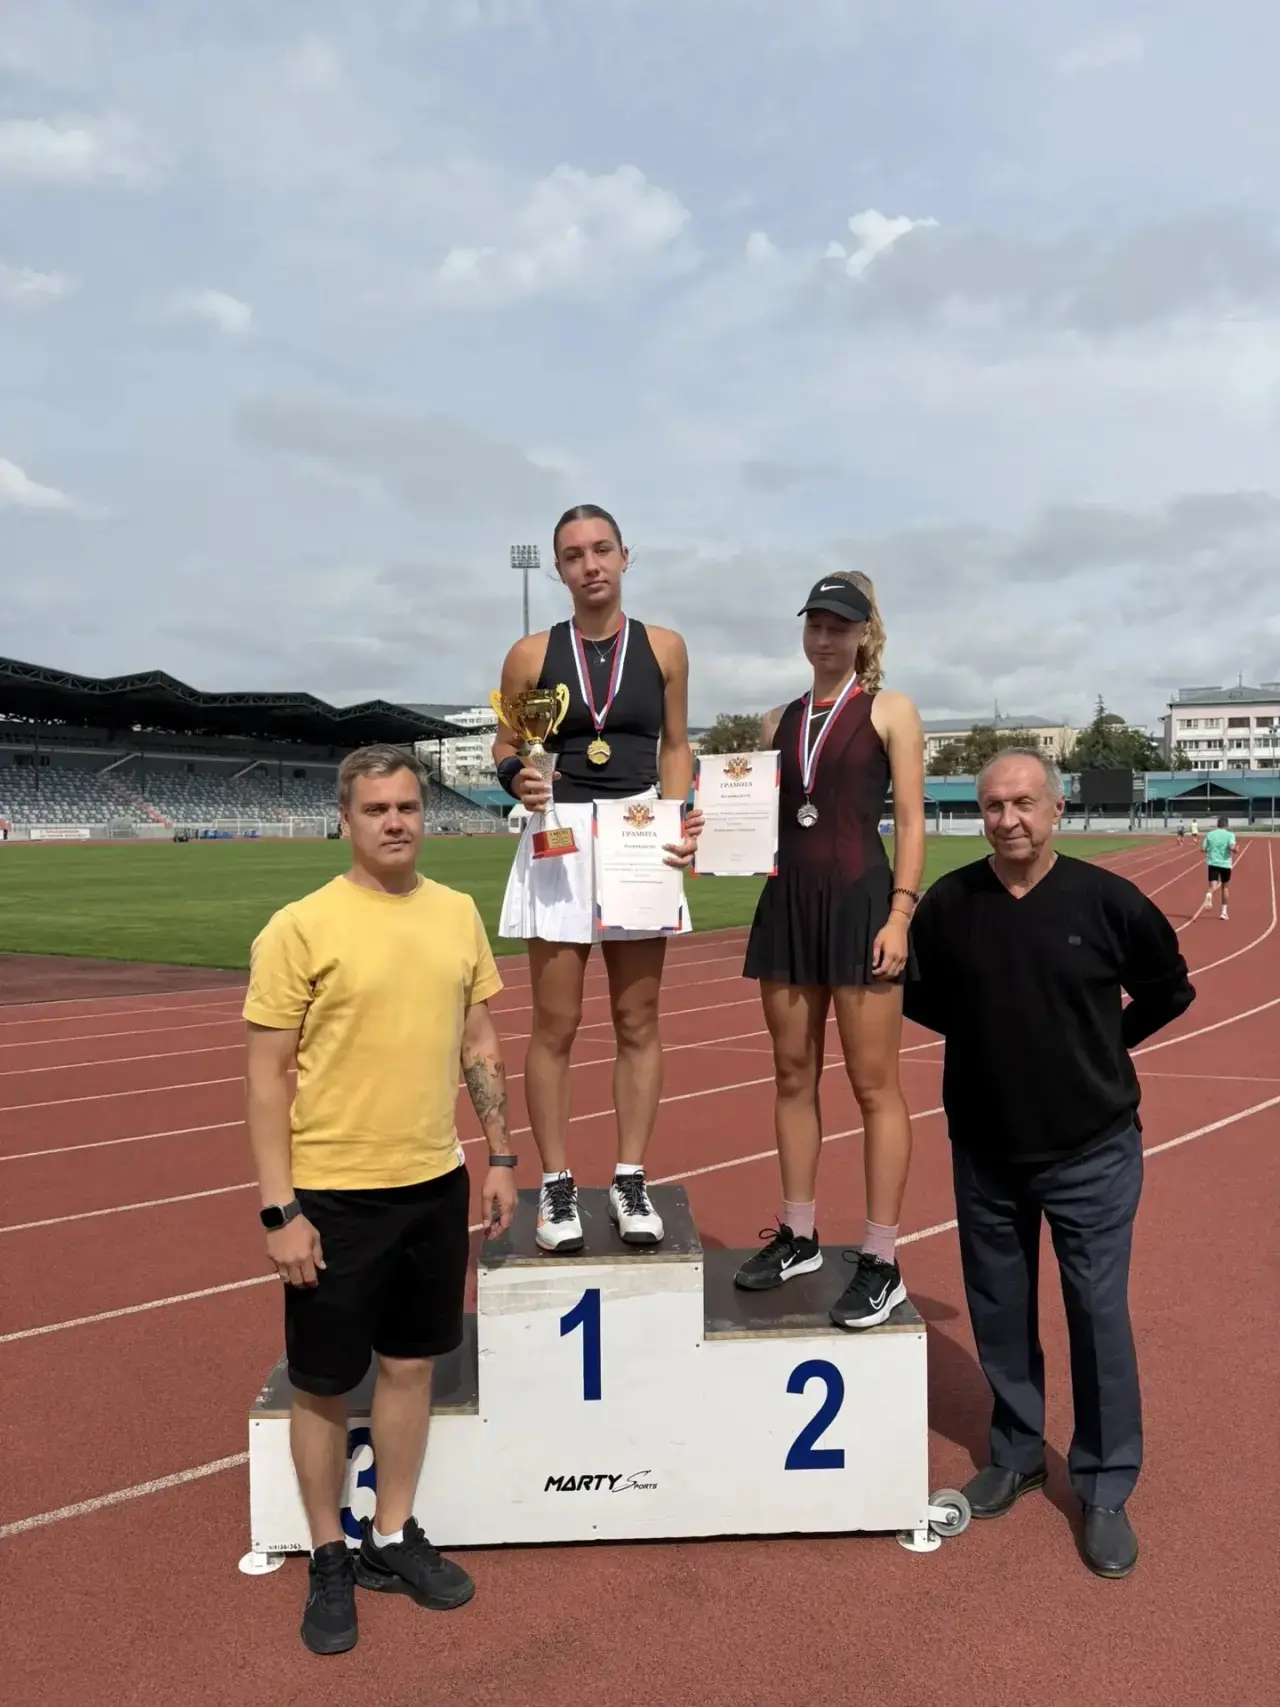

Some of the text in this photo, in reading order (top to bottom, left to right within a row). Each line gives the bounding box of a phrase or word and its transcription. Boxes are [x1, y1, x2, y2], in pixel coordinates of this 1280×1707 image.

[559, 1288, 602, 1401] 1
[785, 1359, 846, 1471] 2
[340, 1427, 377, 1540] 3
[544, 1474, 623, 1492] MARTY
